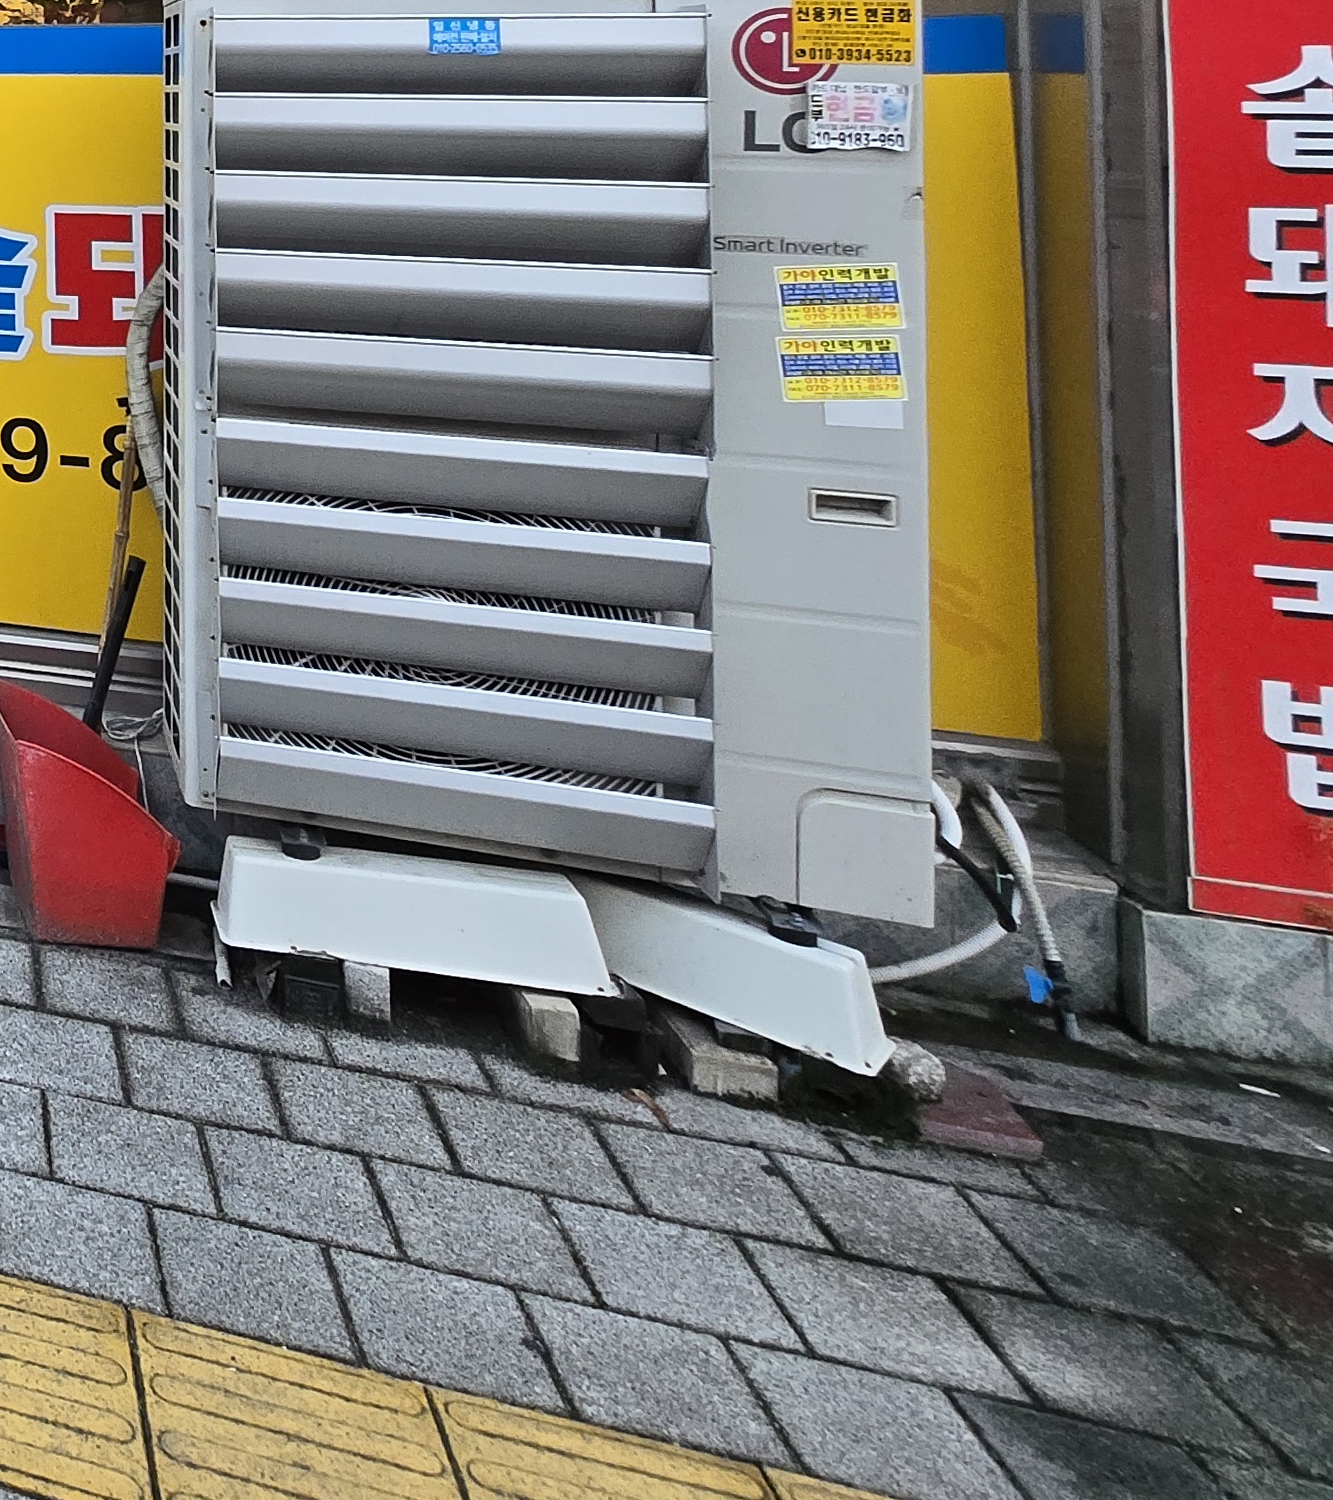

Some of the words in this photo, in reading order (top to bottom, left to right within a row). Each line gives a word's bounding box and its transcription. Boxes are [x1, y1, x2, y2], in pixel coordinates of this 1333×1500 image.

[796, 6, 859, 22] 신용카드
[864, 7, 912, 23] 현금화
[809, 48, 912, 62] 010-3934-5523
[713, 236, 774, 253] Smart
[780, 237, 864, 256] Inverter
